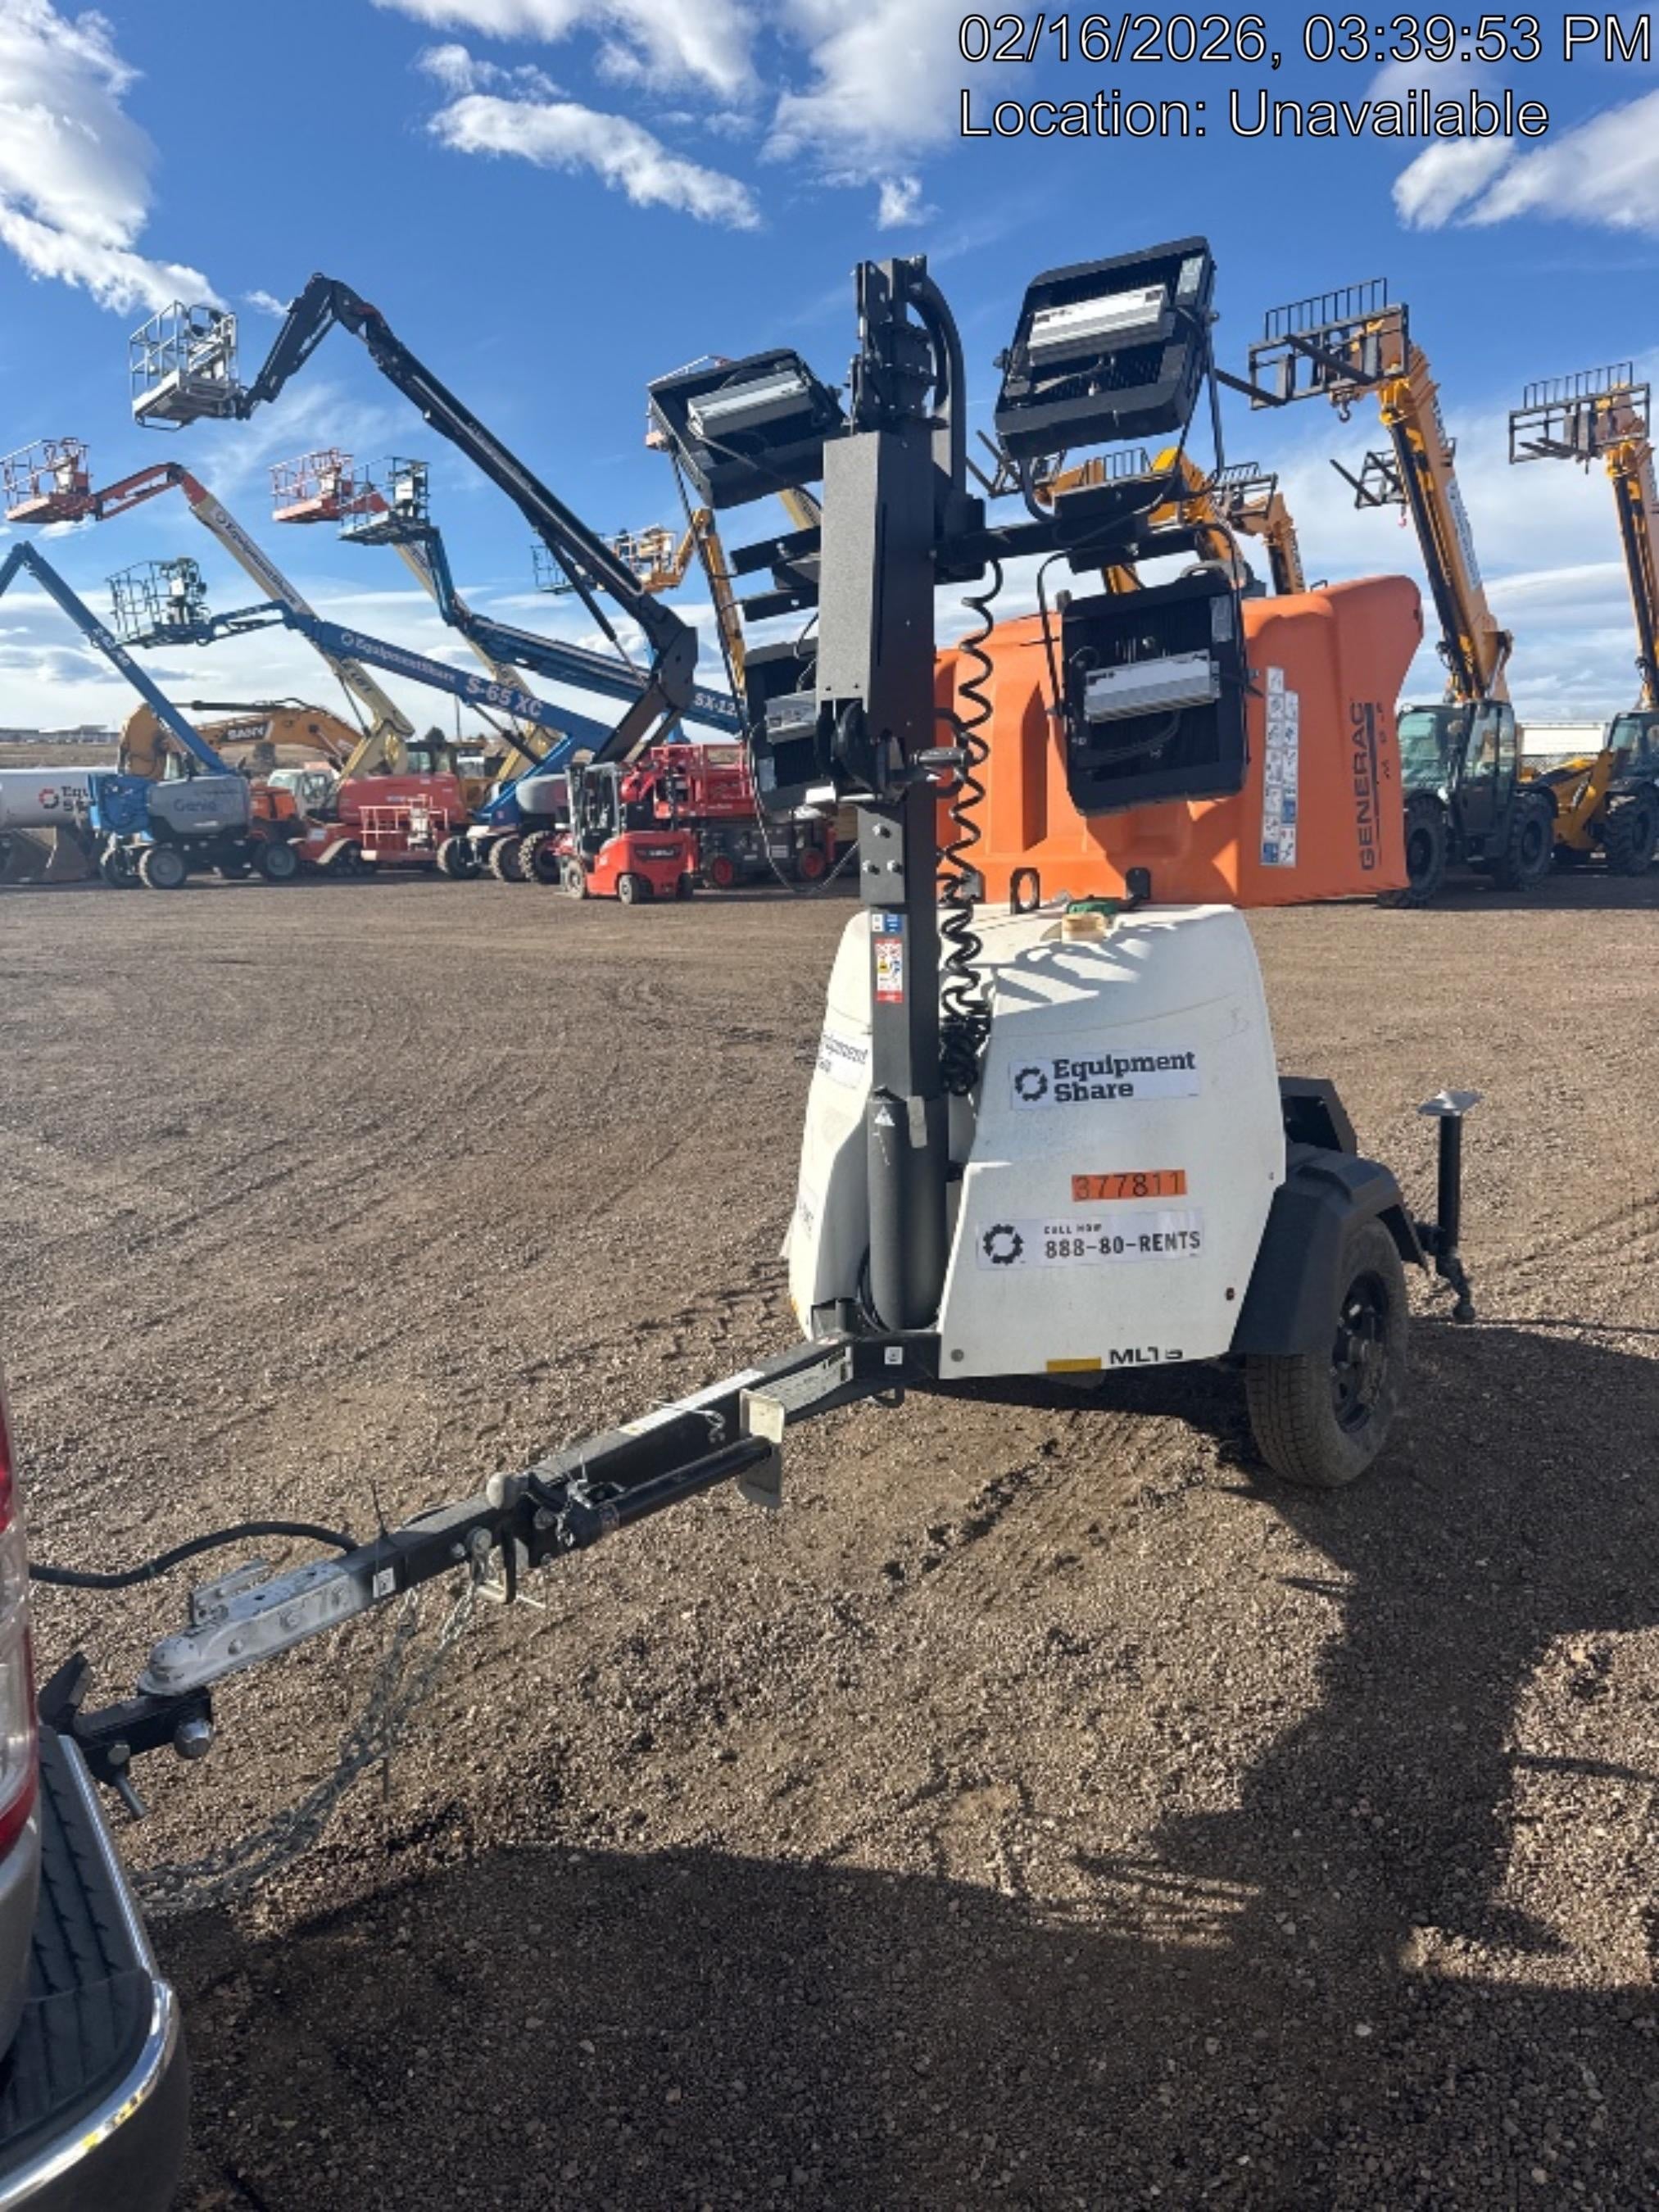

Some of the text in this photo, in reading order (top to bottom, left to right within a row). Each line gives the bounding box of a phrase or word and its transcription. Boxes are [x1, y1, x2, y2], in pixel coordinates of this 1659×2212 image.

[515, 694, 543, 717] XC
[1350, 702, 1376, 871] GENERAC
[1052, 1051, 1196, 1082] Equipment
[1054, 1081, 1134, 1103] Share
[1075, 1172, 1181, 1200] 377811
[1045, 1231, 1201, 1259] 888-80-RENTS
